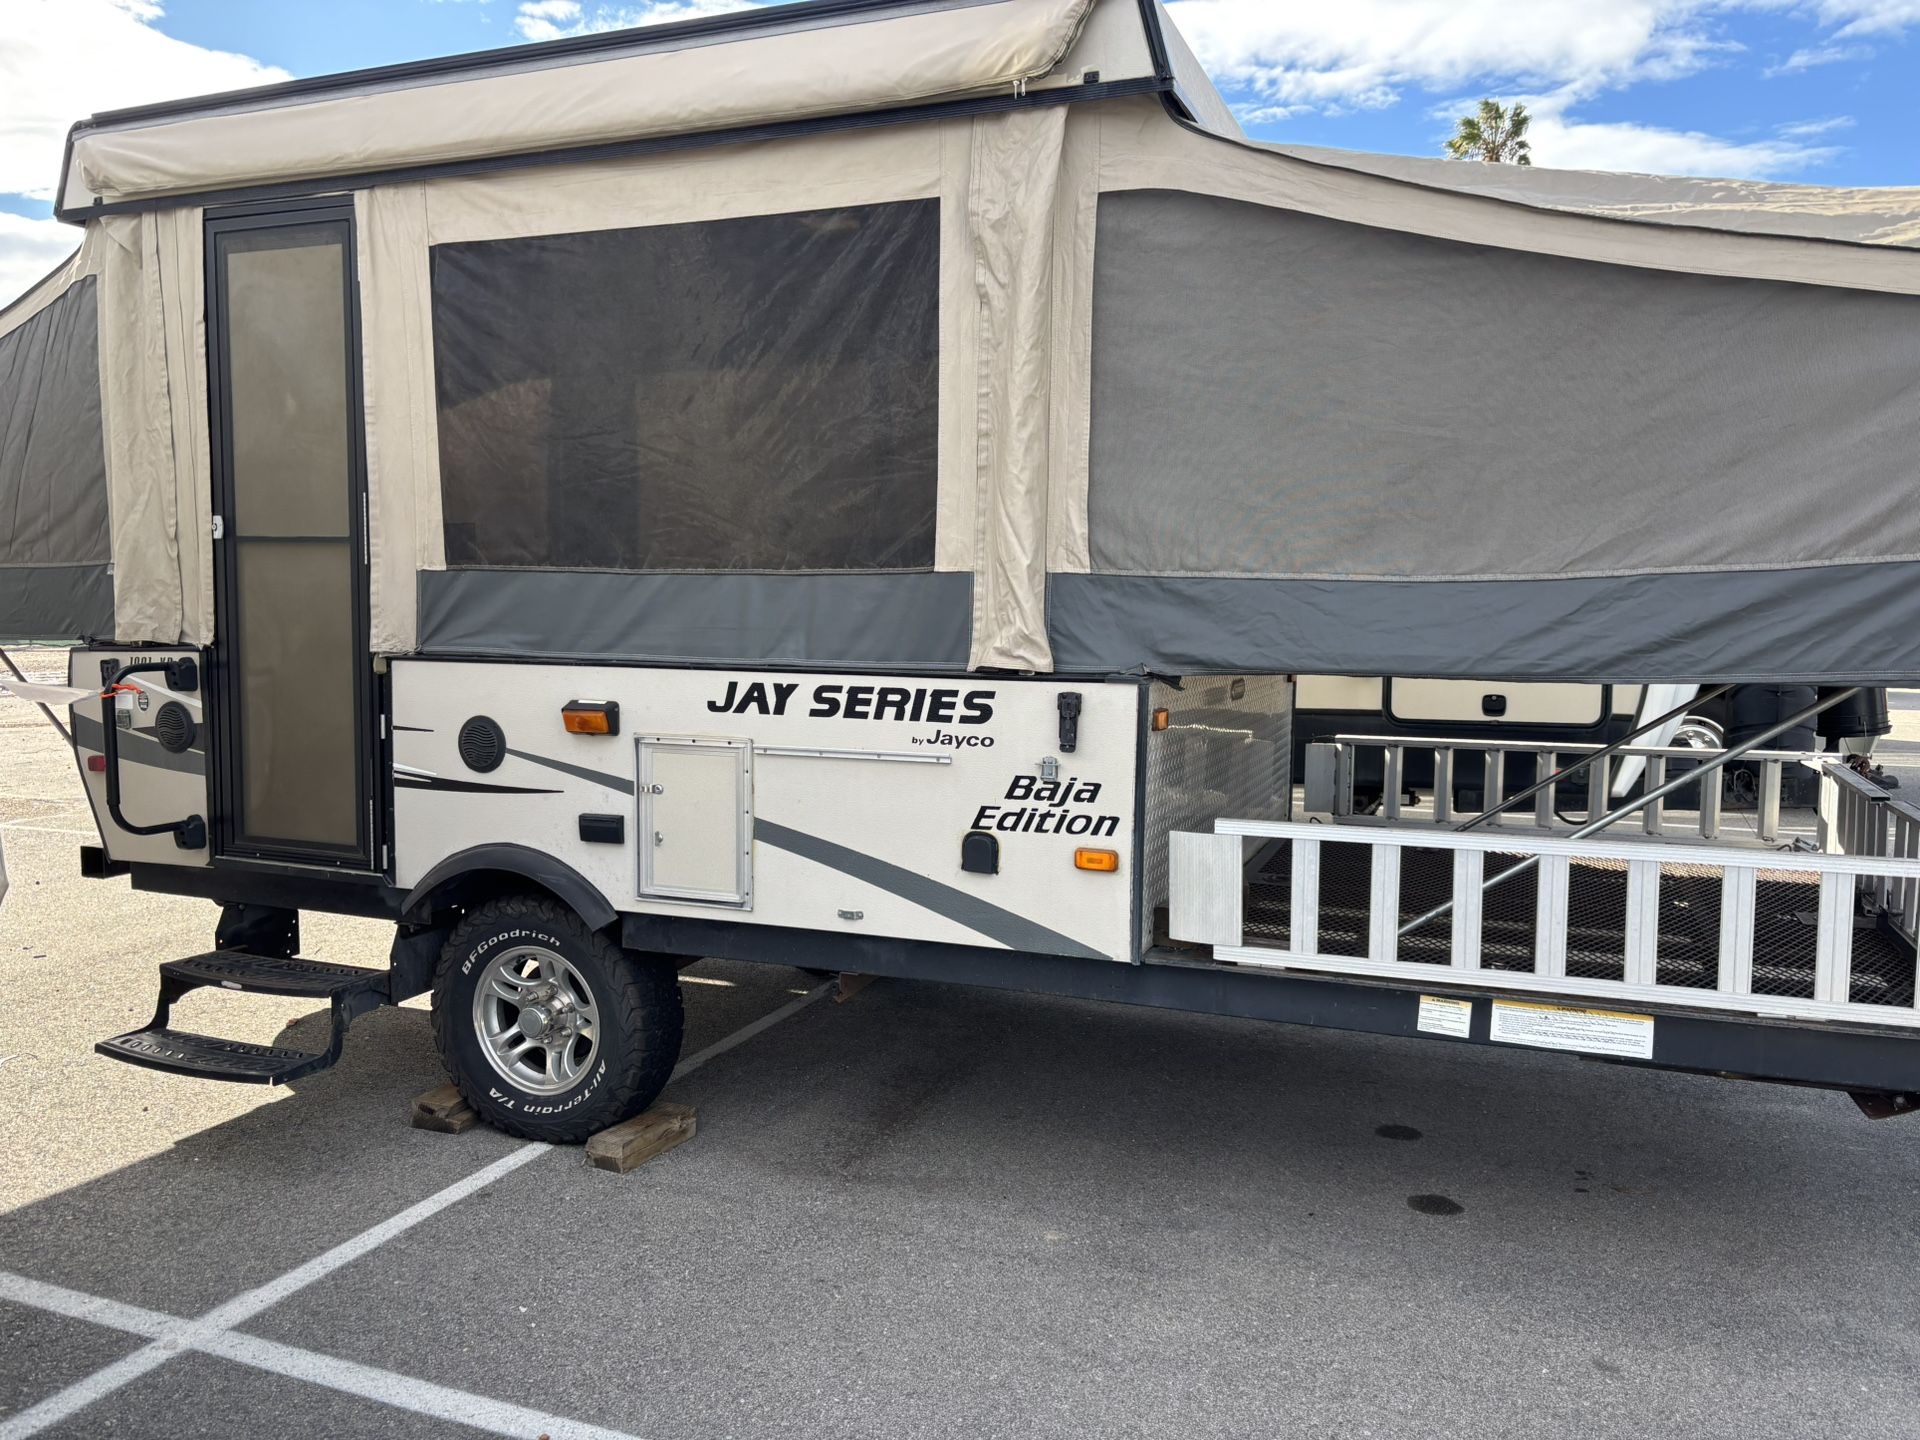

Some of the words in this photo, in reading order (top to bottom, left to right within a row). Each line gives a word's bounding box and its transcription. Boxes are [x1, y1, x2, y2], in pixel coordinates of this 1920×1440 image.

[706, 681, 800, 716] JAY
[808, 684, 997, 725] SERIES
[911, 736, 924, 746] by
[926, 729, 995, 749] Jayco
[1004, 775, 1102, 808] Baja
[970, 805, 1121, 837] Edition
[461, 929, 561, 976] BFGoodrich
[488, 1087, 516, 1110] T/A
[523, 1059, 607, 1116] All-Terrain
